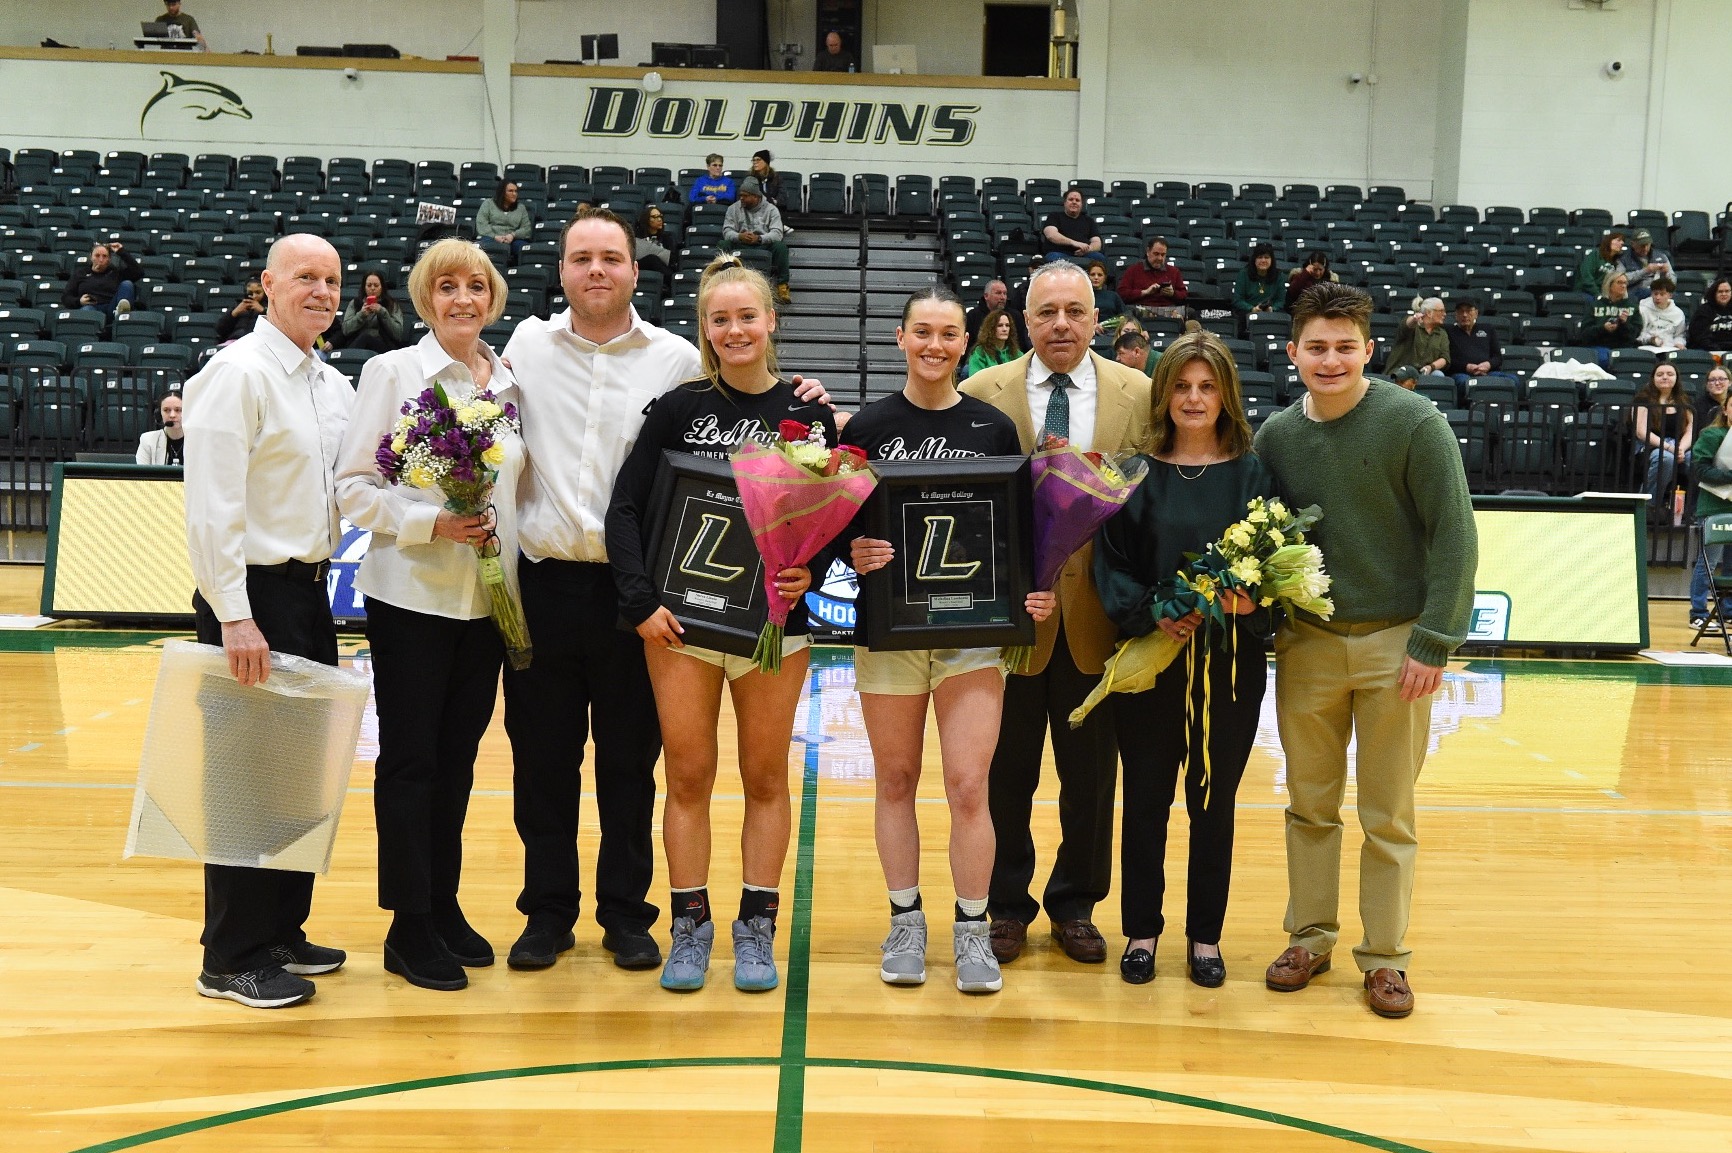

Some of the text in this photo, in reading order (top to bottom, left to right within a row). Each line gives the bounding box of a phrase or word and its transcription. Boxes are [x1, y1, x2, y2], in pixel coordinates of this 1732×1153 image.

[580, 84, 982, 147] DOLPHINS
[1594, 307, 1604, 317] LE
[920, 490, 974, 500] Le Moyne College
[679, 513, 745, 582] L
[915, 515, 982, 580] L
